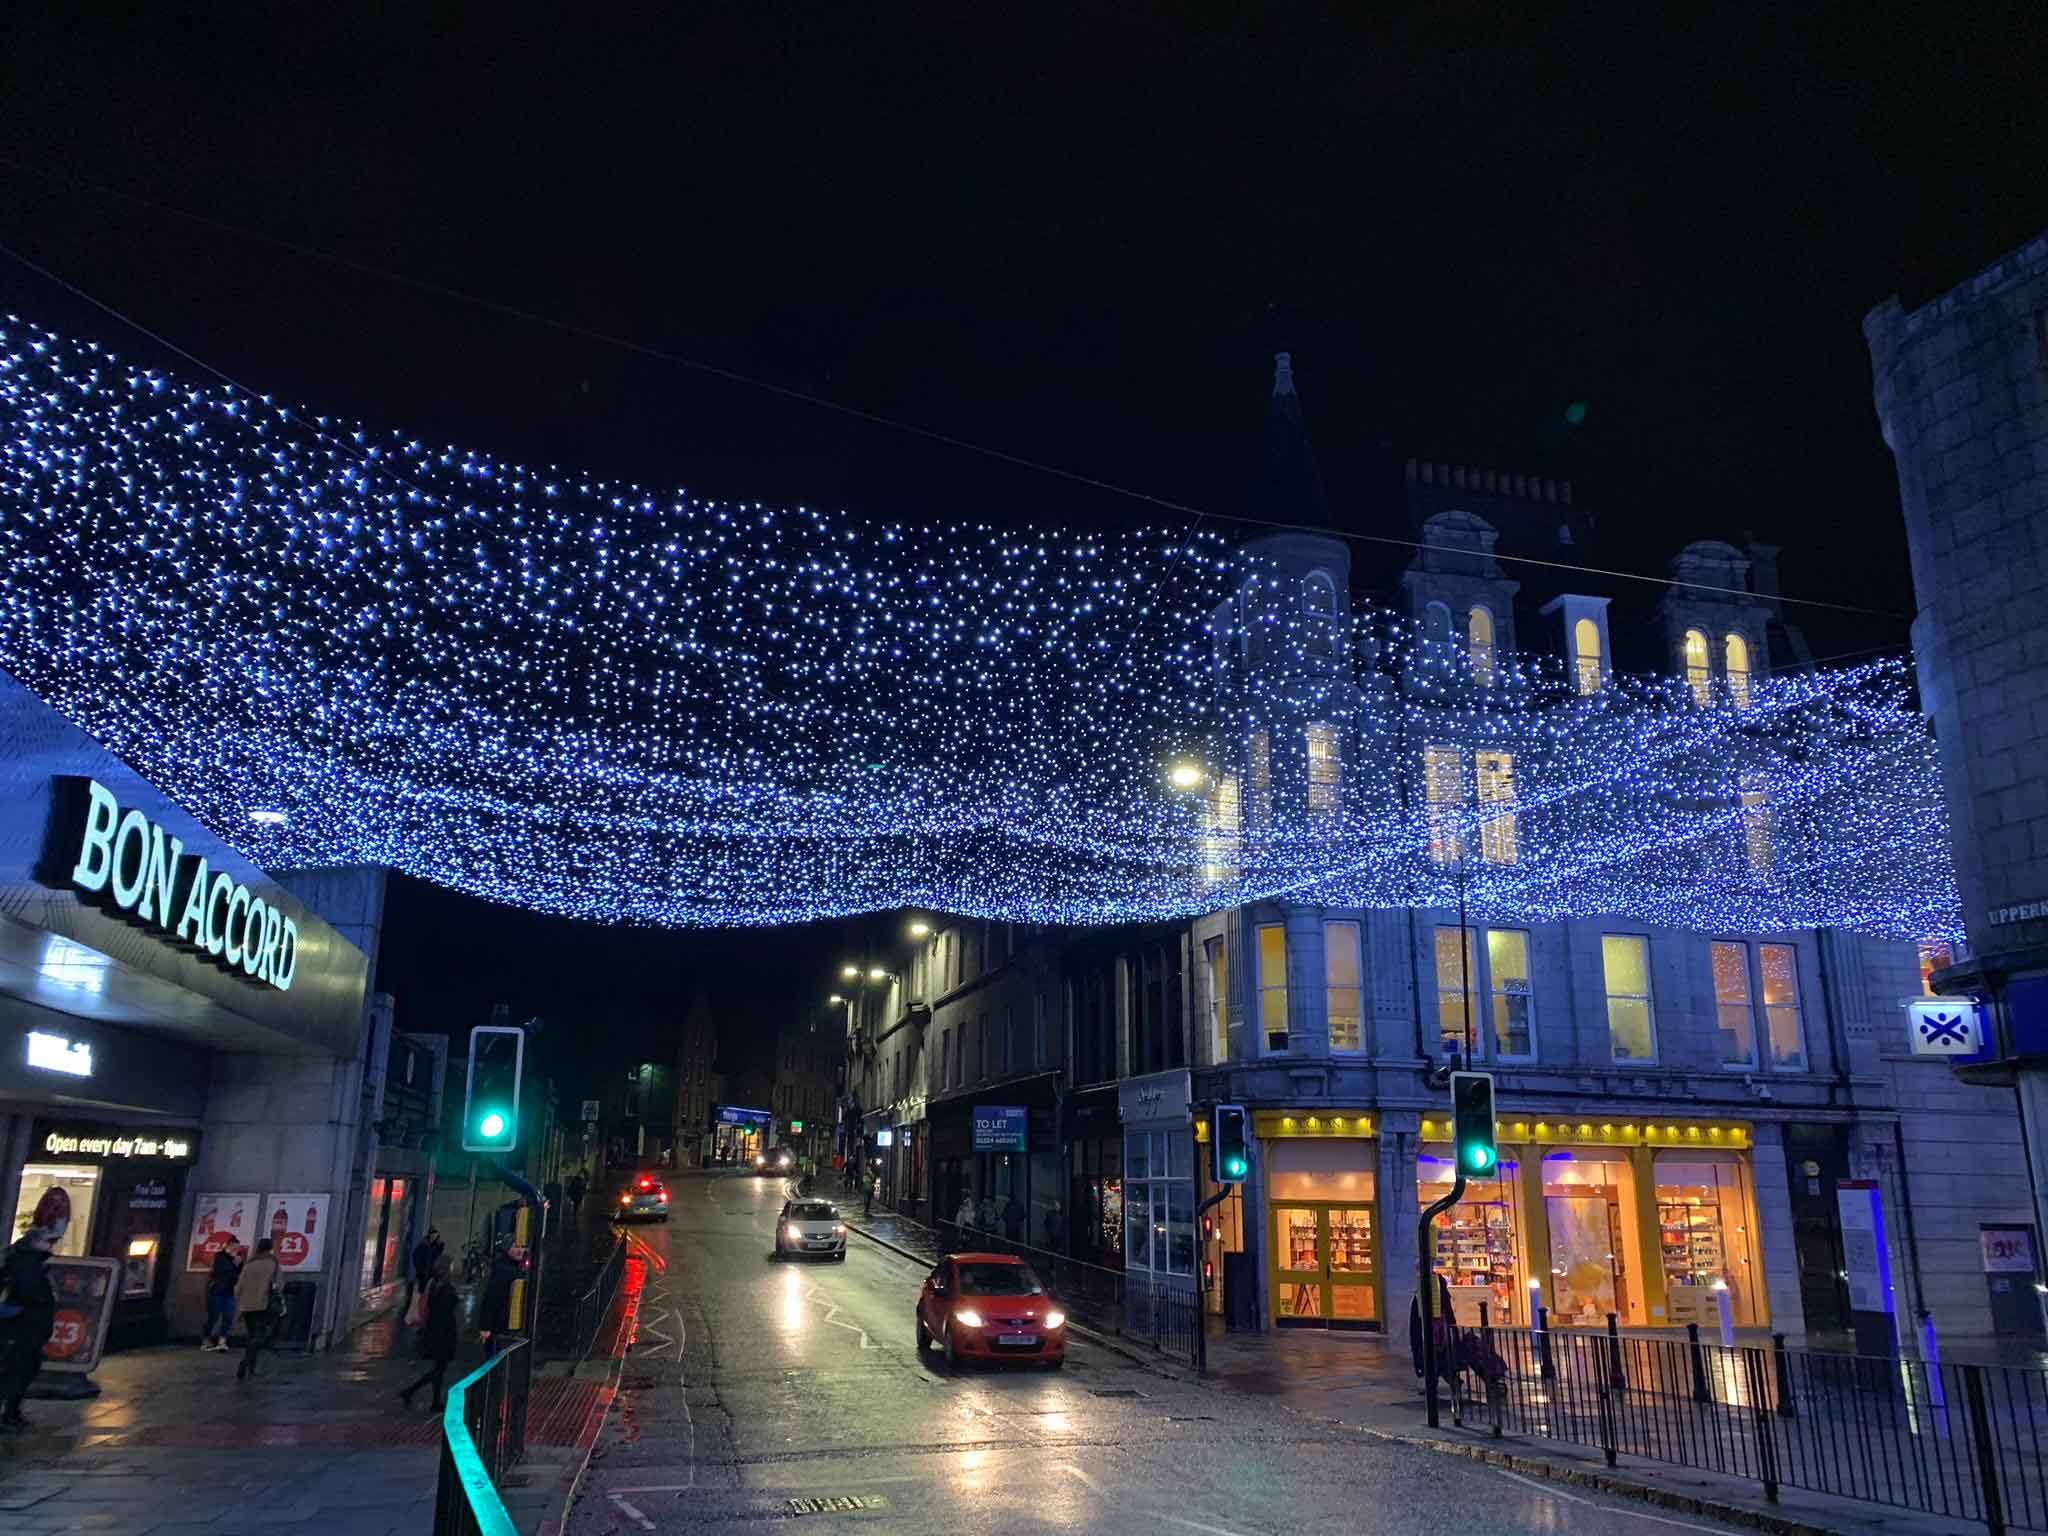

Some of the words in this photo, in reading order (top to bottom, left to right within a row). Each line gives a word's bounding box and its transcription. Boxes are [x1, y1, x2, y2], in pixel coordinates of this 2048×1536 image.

[72, 779, 184, 929] BON
[176, 856, 298, 992] ACCORD
[976, 1119, 990, 1129] TO
[991, 1119, 1008, 1129] LET
[46, 1132, 78, 1155] Open
[79, 1137, 112, 1157] every
[112, 1137, 134, 1158] day
[134, 1138, 157, 1156] 7am
[281, 1237, 303, 1253] £1
[49, 1321, 81, 1344] £3
